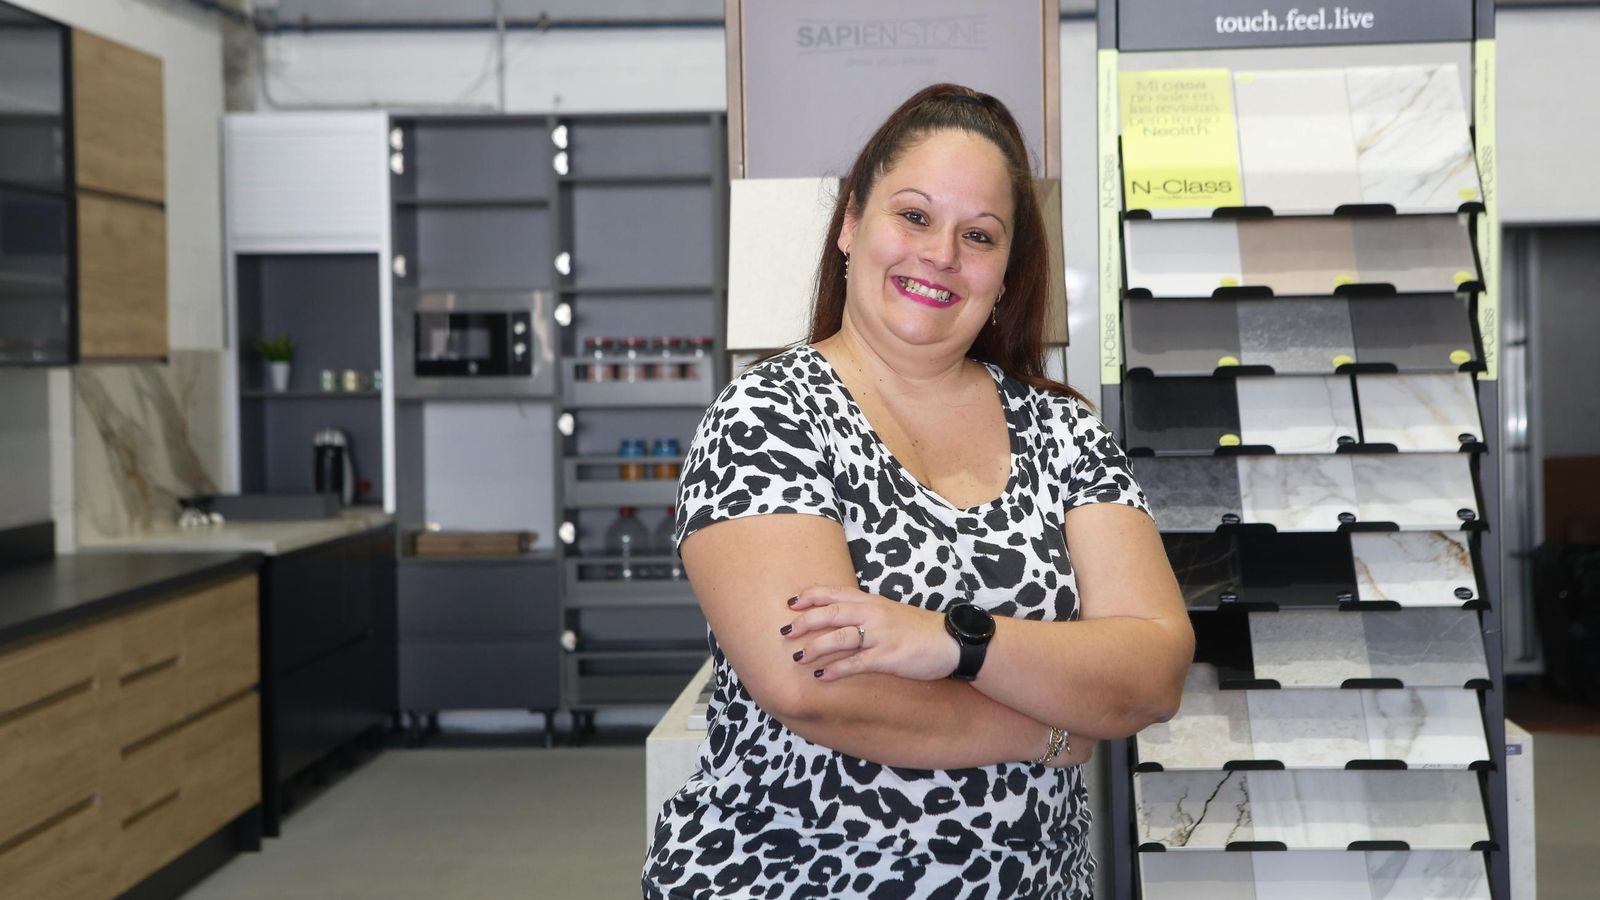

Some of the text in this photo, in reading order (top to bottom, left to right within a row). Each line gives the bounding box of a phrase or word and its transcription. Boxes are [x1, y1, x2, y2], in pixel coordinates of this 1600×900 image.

[1215, 6, 1374, 33] touch.feel.live
[796, 22, 988, 47] SAPIENSTONE
[1142, 124, 1209, 136] Neolith
[1103, 153, 1115, 208] N-Class
[1131, 178, 1232, 195] N-Class
[1104, 313, 1116, 368] N-Class
